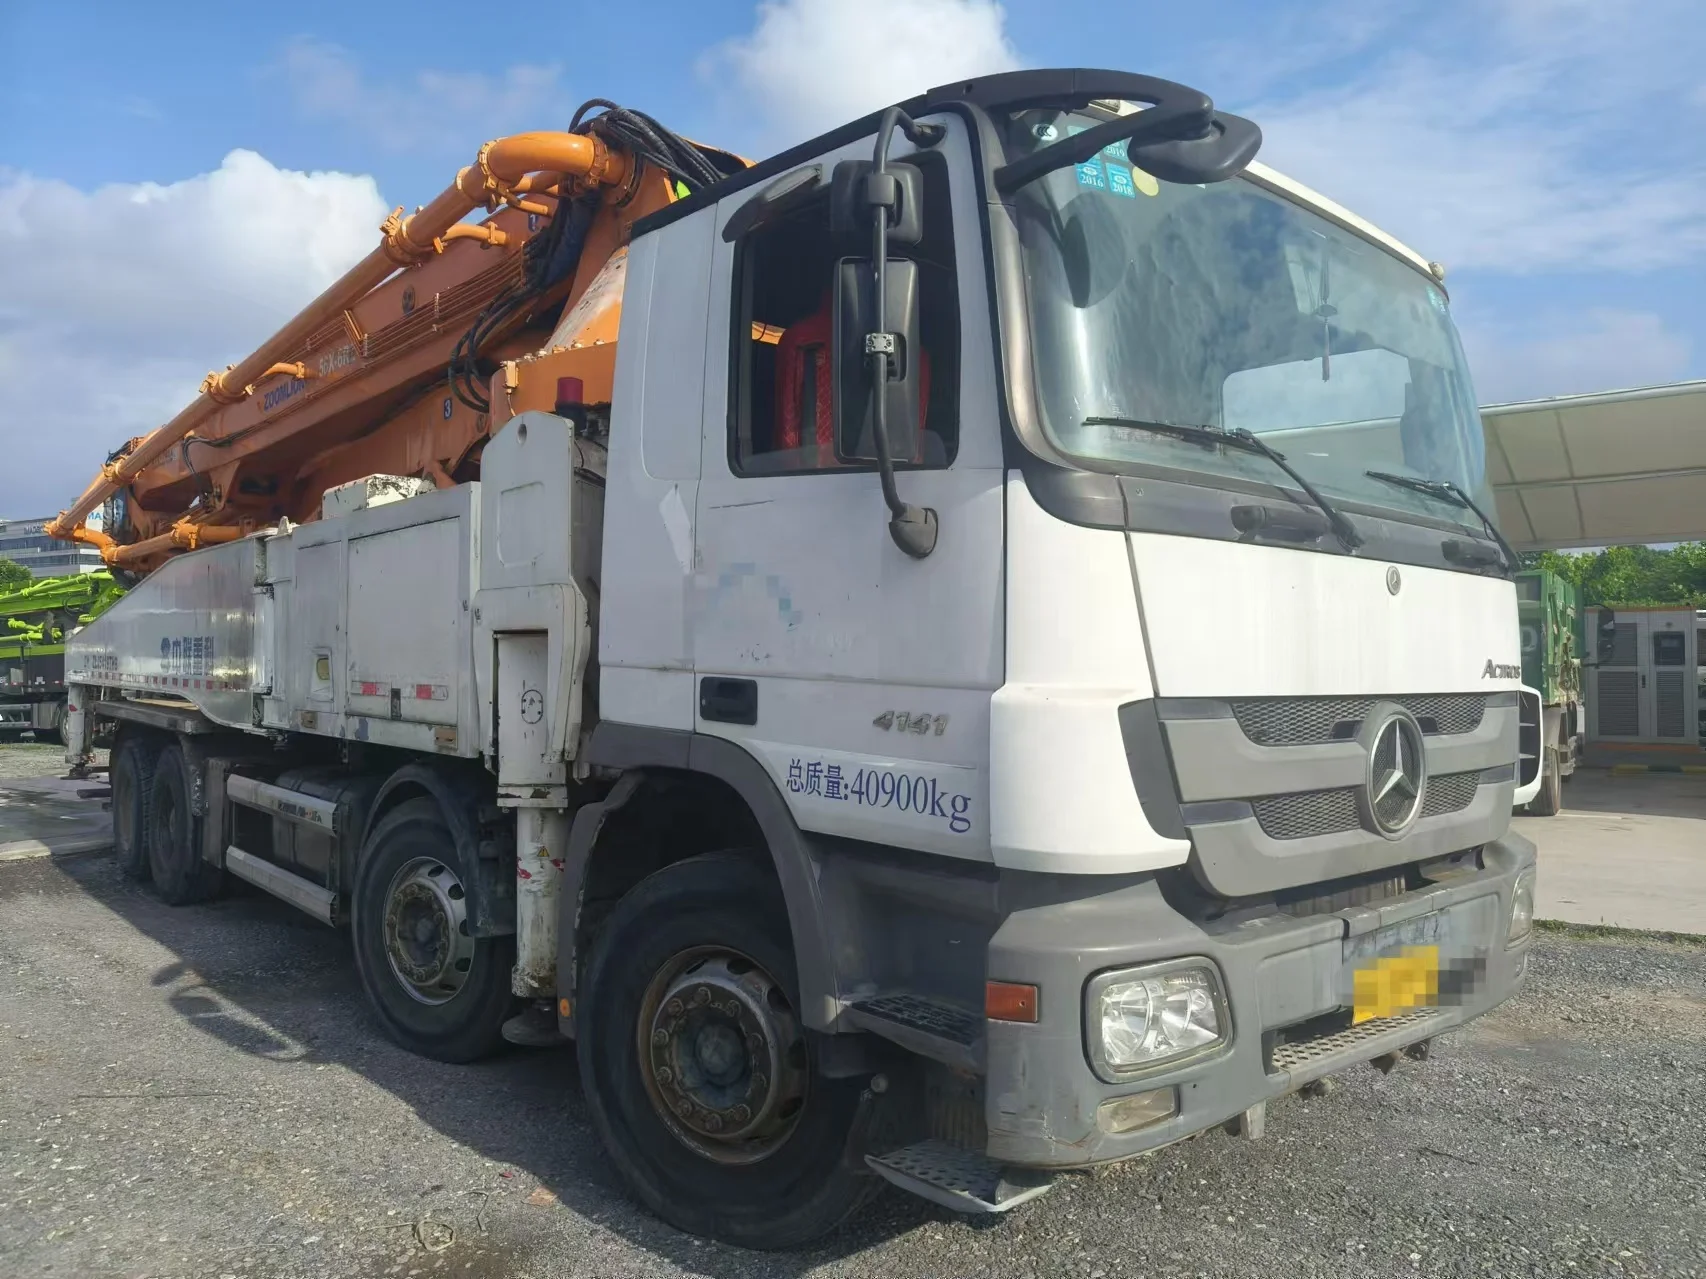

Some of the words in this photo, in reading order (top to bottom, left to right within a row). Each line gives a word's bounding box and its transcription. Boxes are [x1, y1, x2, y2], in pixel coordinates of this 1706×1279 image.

[1106, 145, 1125, 157] 2019
[1081, 174, 1104, 188] 2016
[1113, 182, 1133, 195] 2018
[444, 399, 452, 417] 3
[872, 710, 950, 736] 4141
[786, 758, 972, 833] 总质量:40900kg
